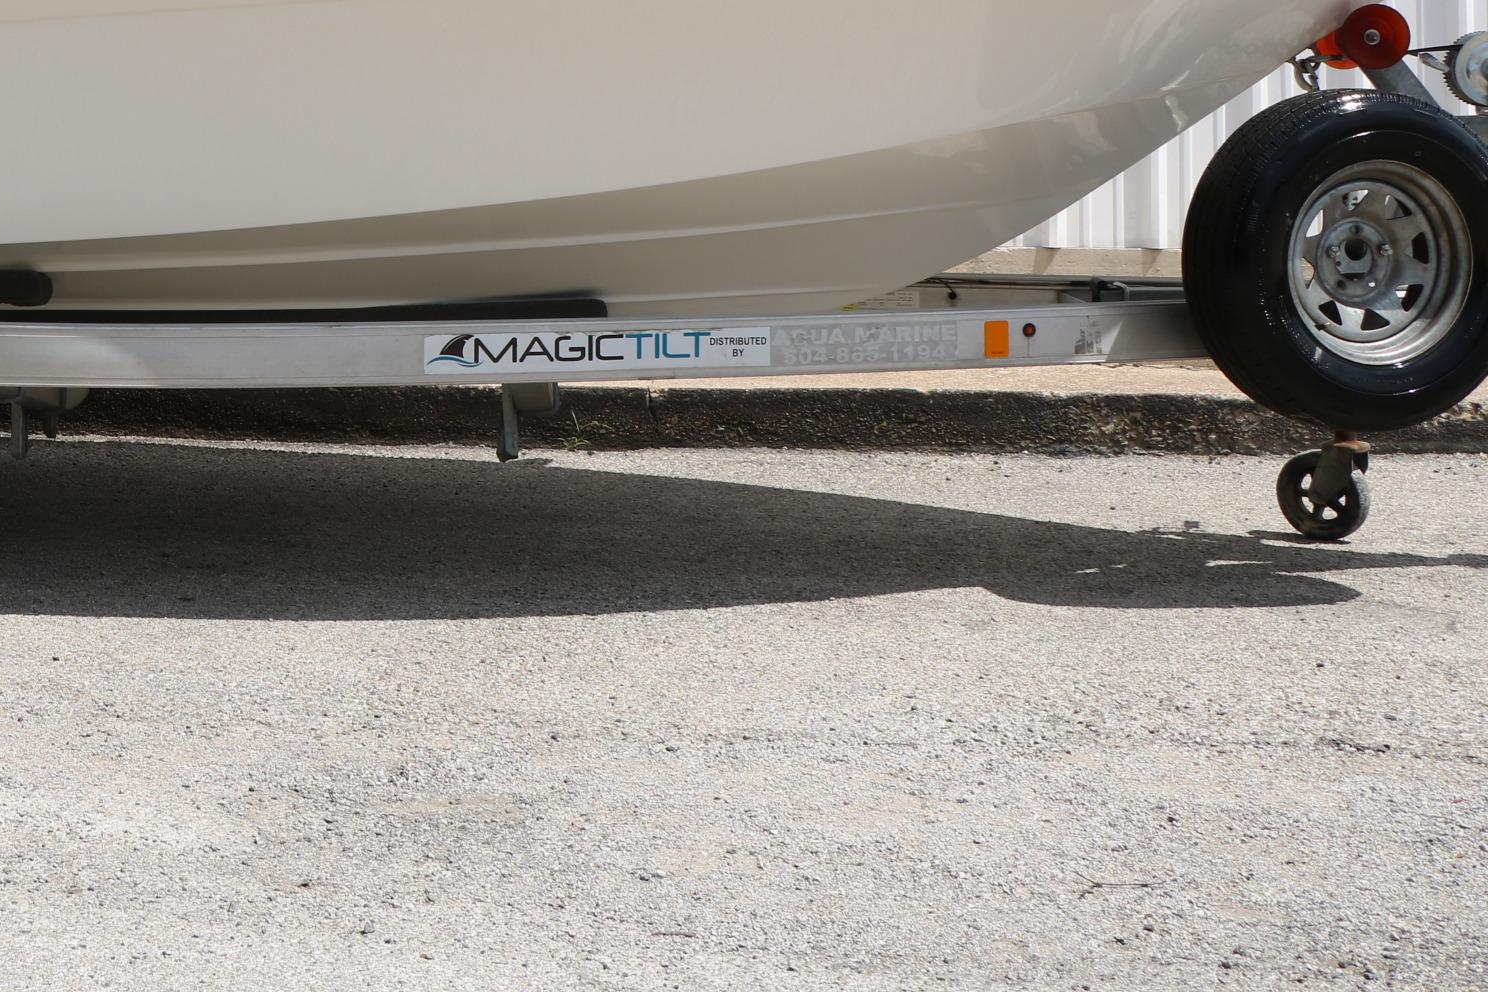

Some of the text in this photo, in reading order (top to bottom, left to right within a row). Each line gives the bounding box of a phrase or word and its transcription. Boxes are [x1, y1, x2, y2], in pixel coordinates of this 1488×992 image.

[854, 324, 957, 344] MARINE
[709, 336, 767, 347] DISTRIBUTED
[731, 348, 745, 358] BY
